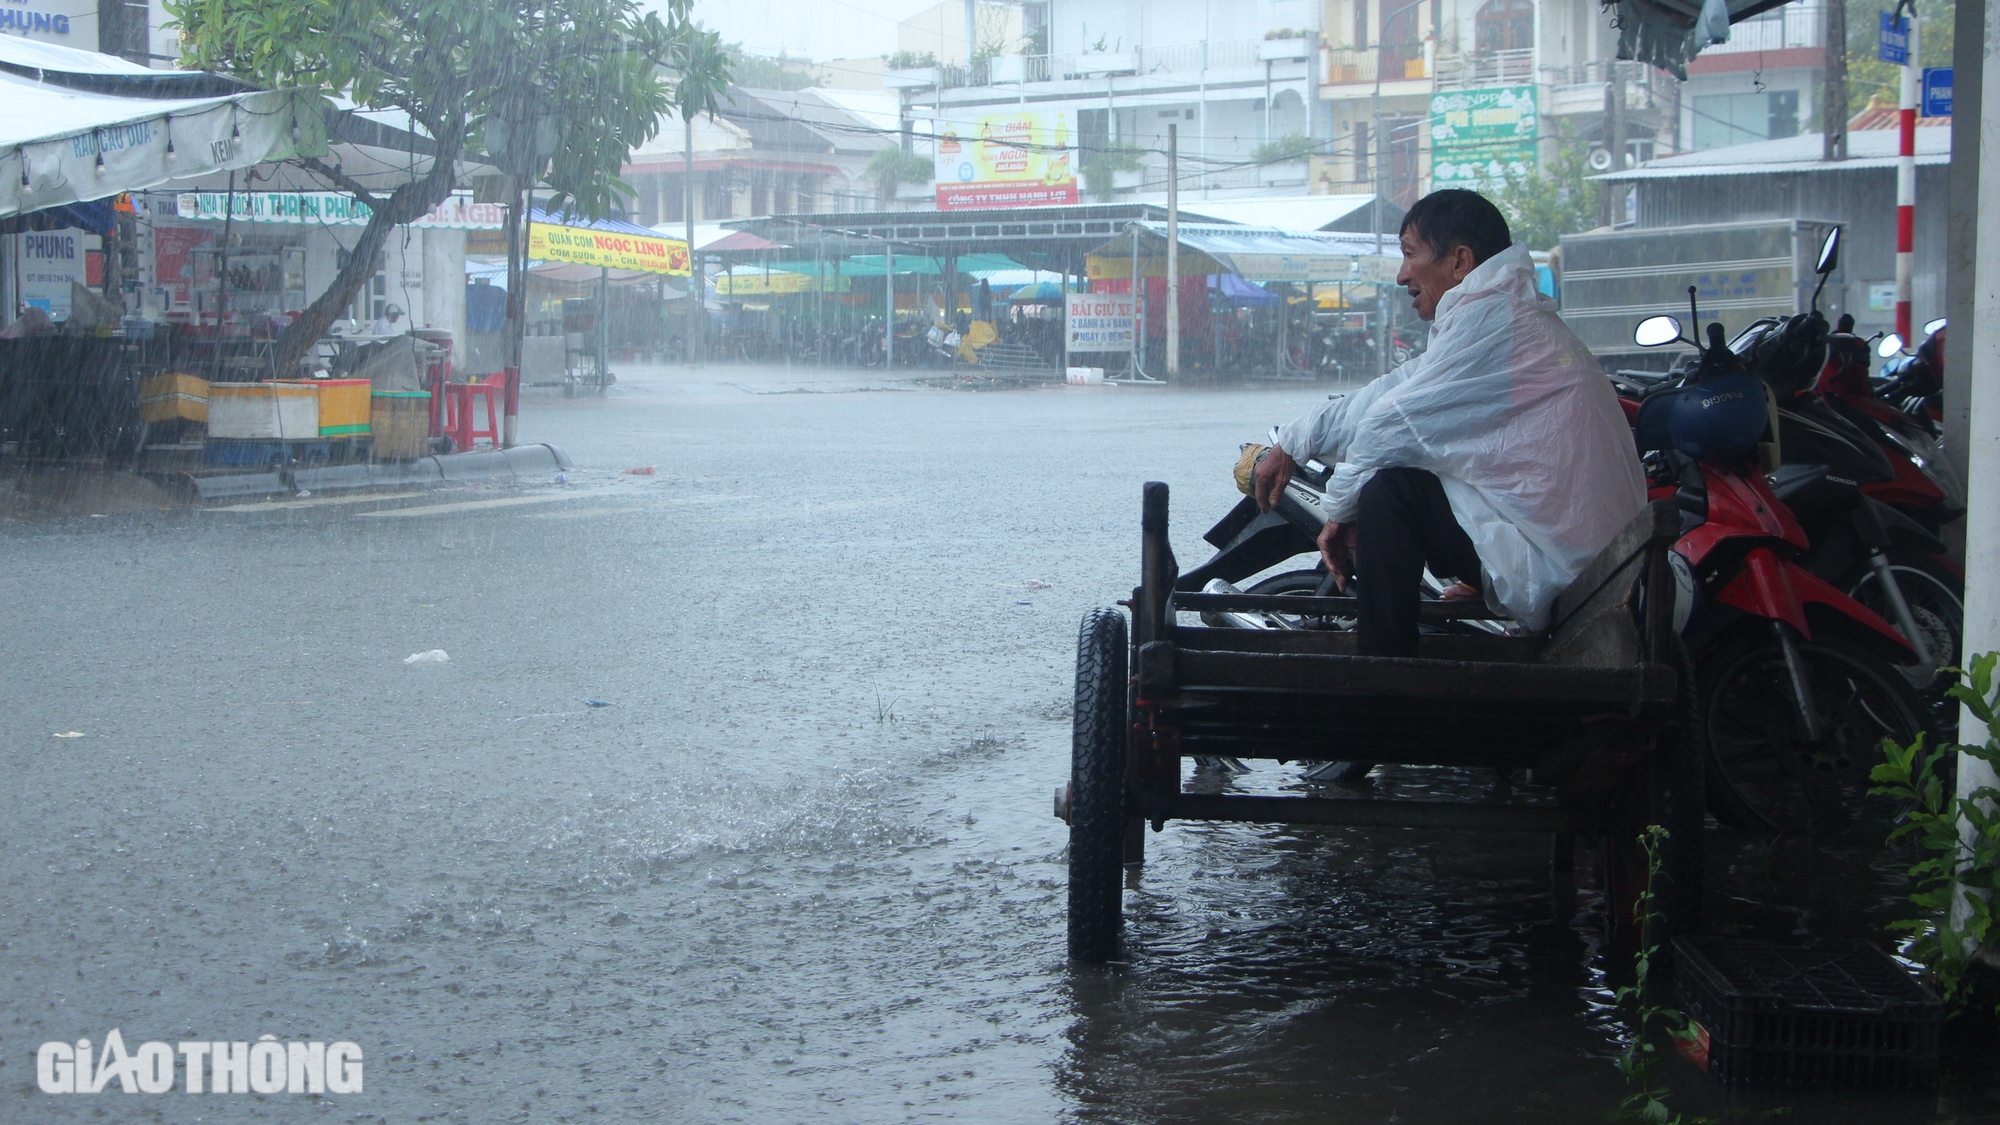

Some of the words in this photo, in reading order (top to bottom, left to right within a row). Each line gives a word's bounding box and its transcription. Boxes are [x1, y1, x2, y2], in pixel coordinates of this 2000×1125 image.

[210, 138, 234, 164] KEM
[268, 194, 320, 218] THANH
[948, 193, 973, 205] CÔNG
[975, 194, 987, 204] TY
[989, 193, 1017, 202] TNHH
[158, 200, 178, 216] THAN
[25, 235, 75, 265] PHỤNG
[548, 230, 572, 246] QUÁN
[573, 234, 594, 248] CƠM
[594, 235, 631, 256] NGỌC
[633, 240, 666, 258] LINH
[550, 248, 570, 258] CƠM
[1071, 300, 1091, 316] BÃI
[1095, 300, 1116, 316] GIỮ
[1117, 303, 1132, 316] XE
[1071, 318, 1077, 328] 2
[1099, 318, 1105, 328] &
[1701, 390, 1744, 410] PIAGGIO
[1826, 474, 1858, 487] HONDA
